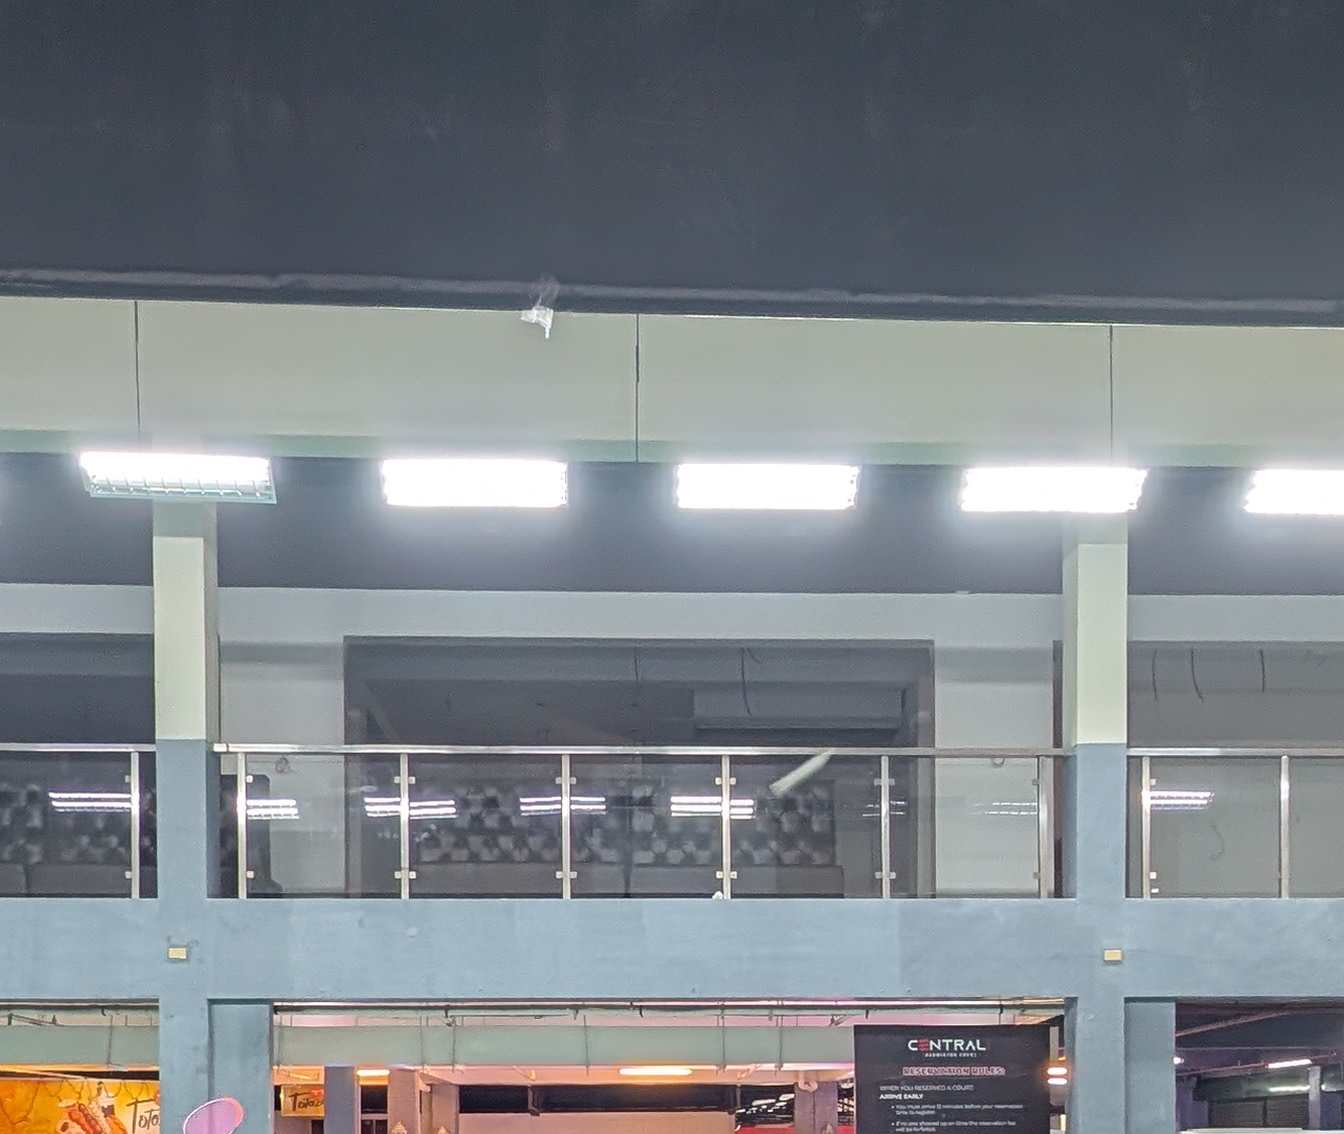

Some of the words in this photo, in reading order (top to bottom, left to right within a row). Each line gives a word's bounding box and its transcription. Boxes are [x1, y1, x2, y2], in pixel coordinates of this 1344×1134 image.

[908, 1039, 986, 1051] CENTRAL
[902, 1066, 970, 1076] RESERVATION
[971, 1066, 1006, 1076] RULES:
